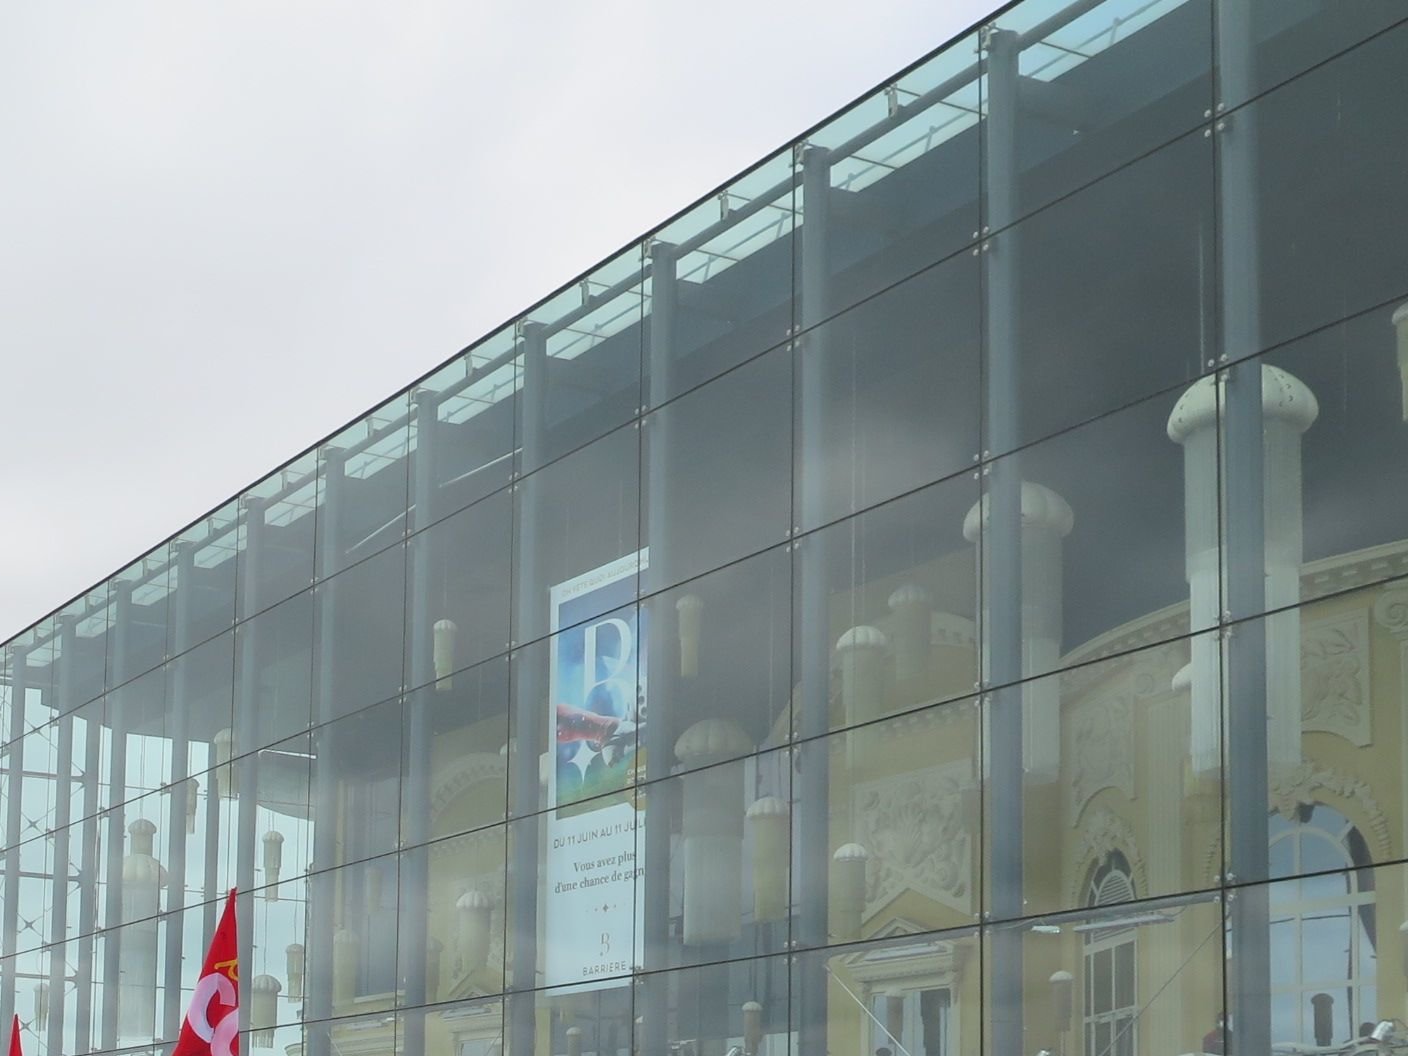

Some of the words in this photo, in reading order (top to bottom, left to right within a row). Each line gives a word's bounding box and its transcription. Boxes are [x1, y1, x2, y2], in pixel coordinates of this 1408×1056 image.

[553, 835, 565, 849] DU
[577, 829, 598, 844] JUIN
[600, 825, 613, 838] AU
[573, 861, 595, 872] Vous
[597, 856, 617, 868] avez
[554, 881, 578, 894] d'une
[579, 876, 610, 889] chance
[611, 870, 623, 882] de
